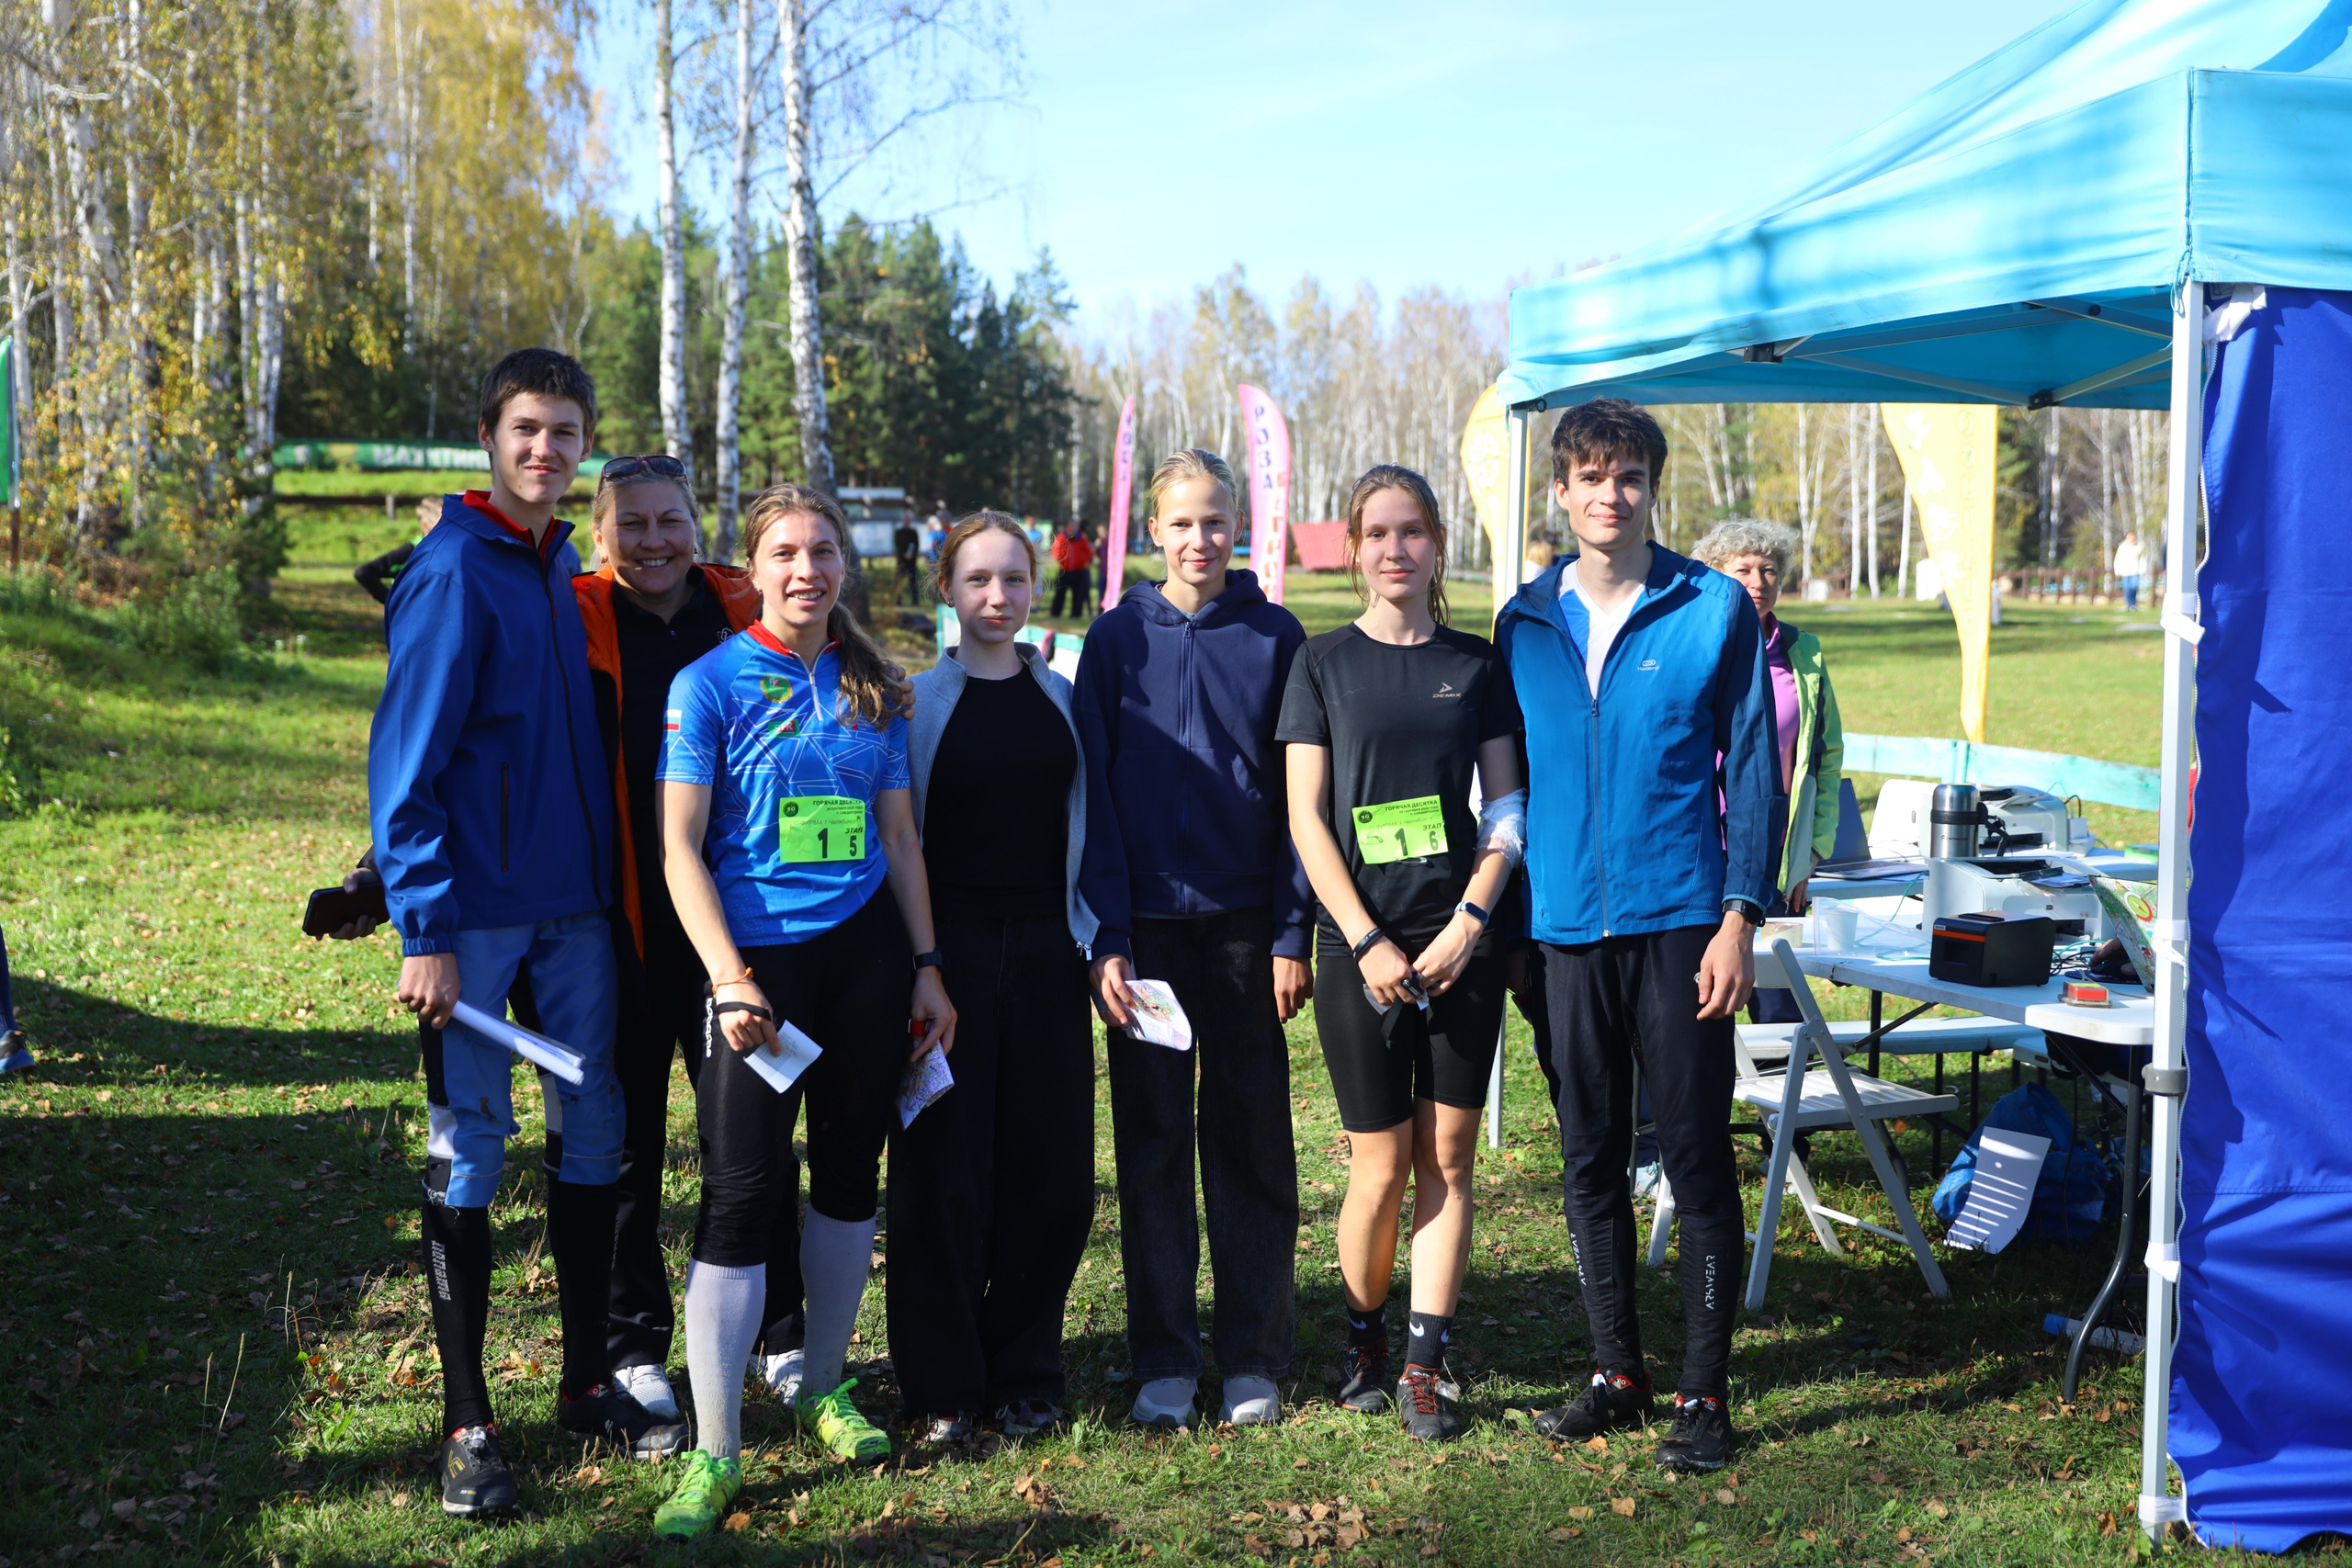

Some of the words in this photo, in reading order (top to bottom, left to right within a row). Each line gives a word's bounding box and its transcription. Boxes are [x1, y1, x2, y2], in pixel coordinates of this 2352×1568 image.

[1255, 405, 1273, 490] РОЗА
[1385, 803, 1411, 811] ГОРЯЧАЯ
[1411, 799, 1438, 808] ДЕСЯТКА
[818, 828, 828, 859] 1
[849, 835, 857, 857] 5
[1394, 828, 1408, 857] 1
[1429, 830, 1439, 852] 6
[1705, 1255, 1716, 1310] ARSWEAR
